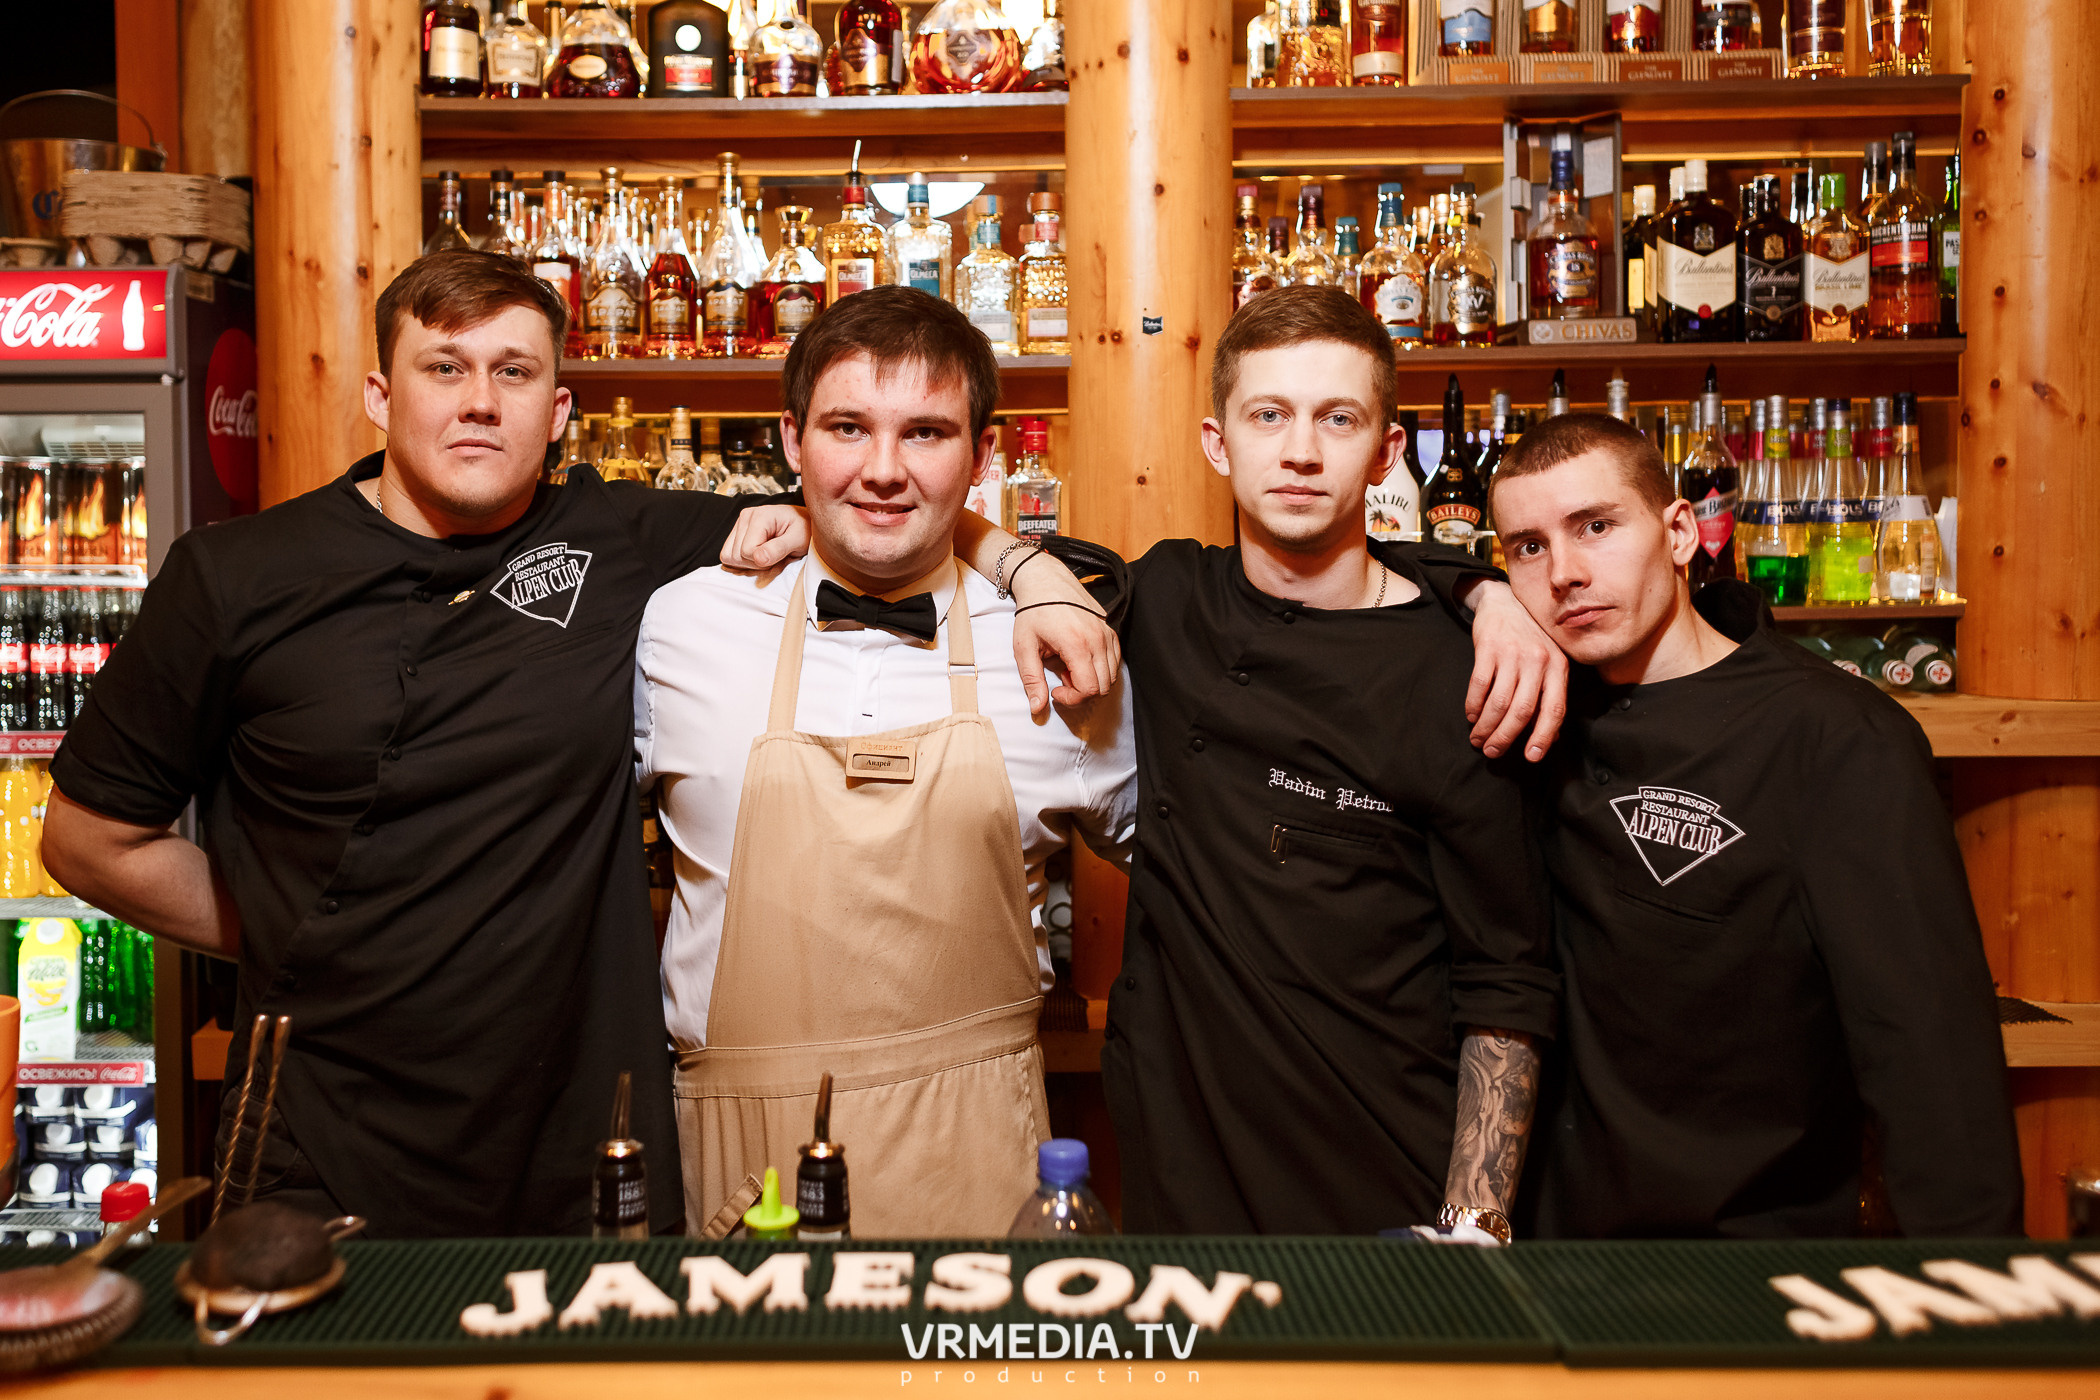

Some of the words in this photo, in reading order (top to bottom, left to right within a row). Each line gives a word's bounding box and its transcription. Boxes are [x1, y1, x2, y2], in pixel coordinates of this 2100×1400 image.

[1561, 322, 1633, 339] CHIVAS
[1017, 519, 1058, 532] BEEFEATER
[1430, 505, 1477, 521] BAILEYS
[512, 554, 536, 572] GRAND
[536, 546, 565, 560] RESORT
[514, 555, 566, 582] RESTAURANT
[511, 573, 552, 609] ALPEN
[549, 558, 584, 592] CLUB
[866, 759, 892, 768] Андрей
[1268, 768, 1326, 800] Vadim
[1641, 800, 1711, 826] RESTAURANT
[1642, 790, 1677, 802] GRAND
[1677, 795, 1715, 814] RESORT
[1625, 806, 1681, 846] ALPEN
[1679, 822, 1723, 855] CLUB
[459, 1251, 1254, 1336] JAMESON
[1767, 1252, 2100, 1342] JAM
